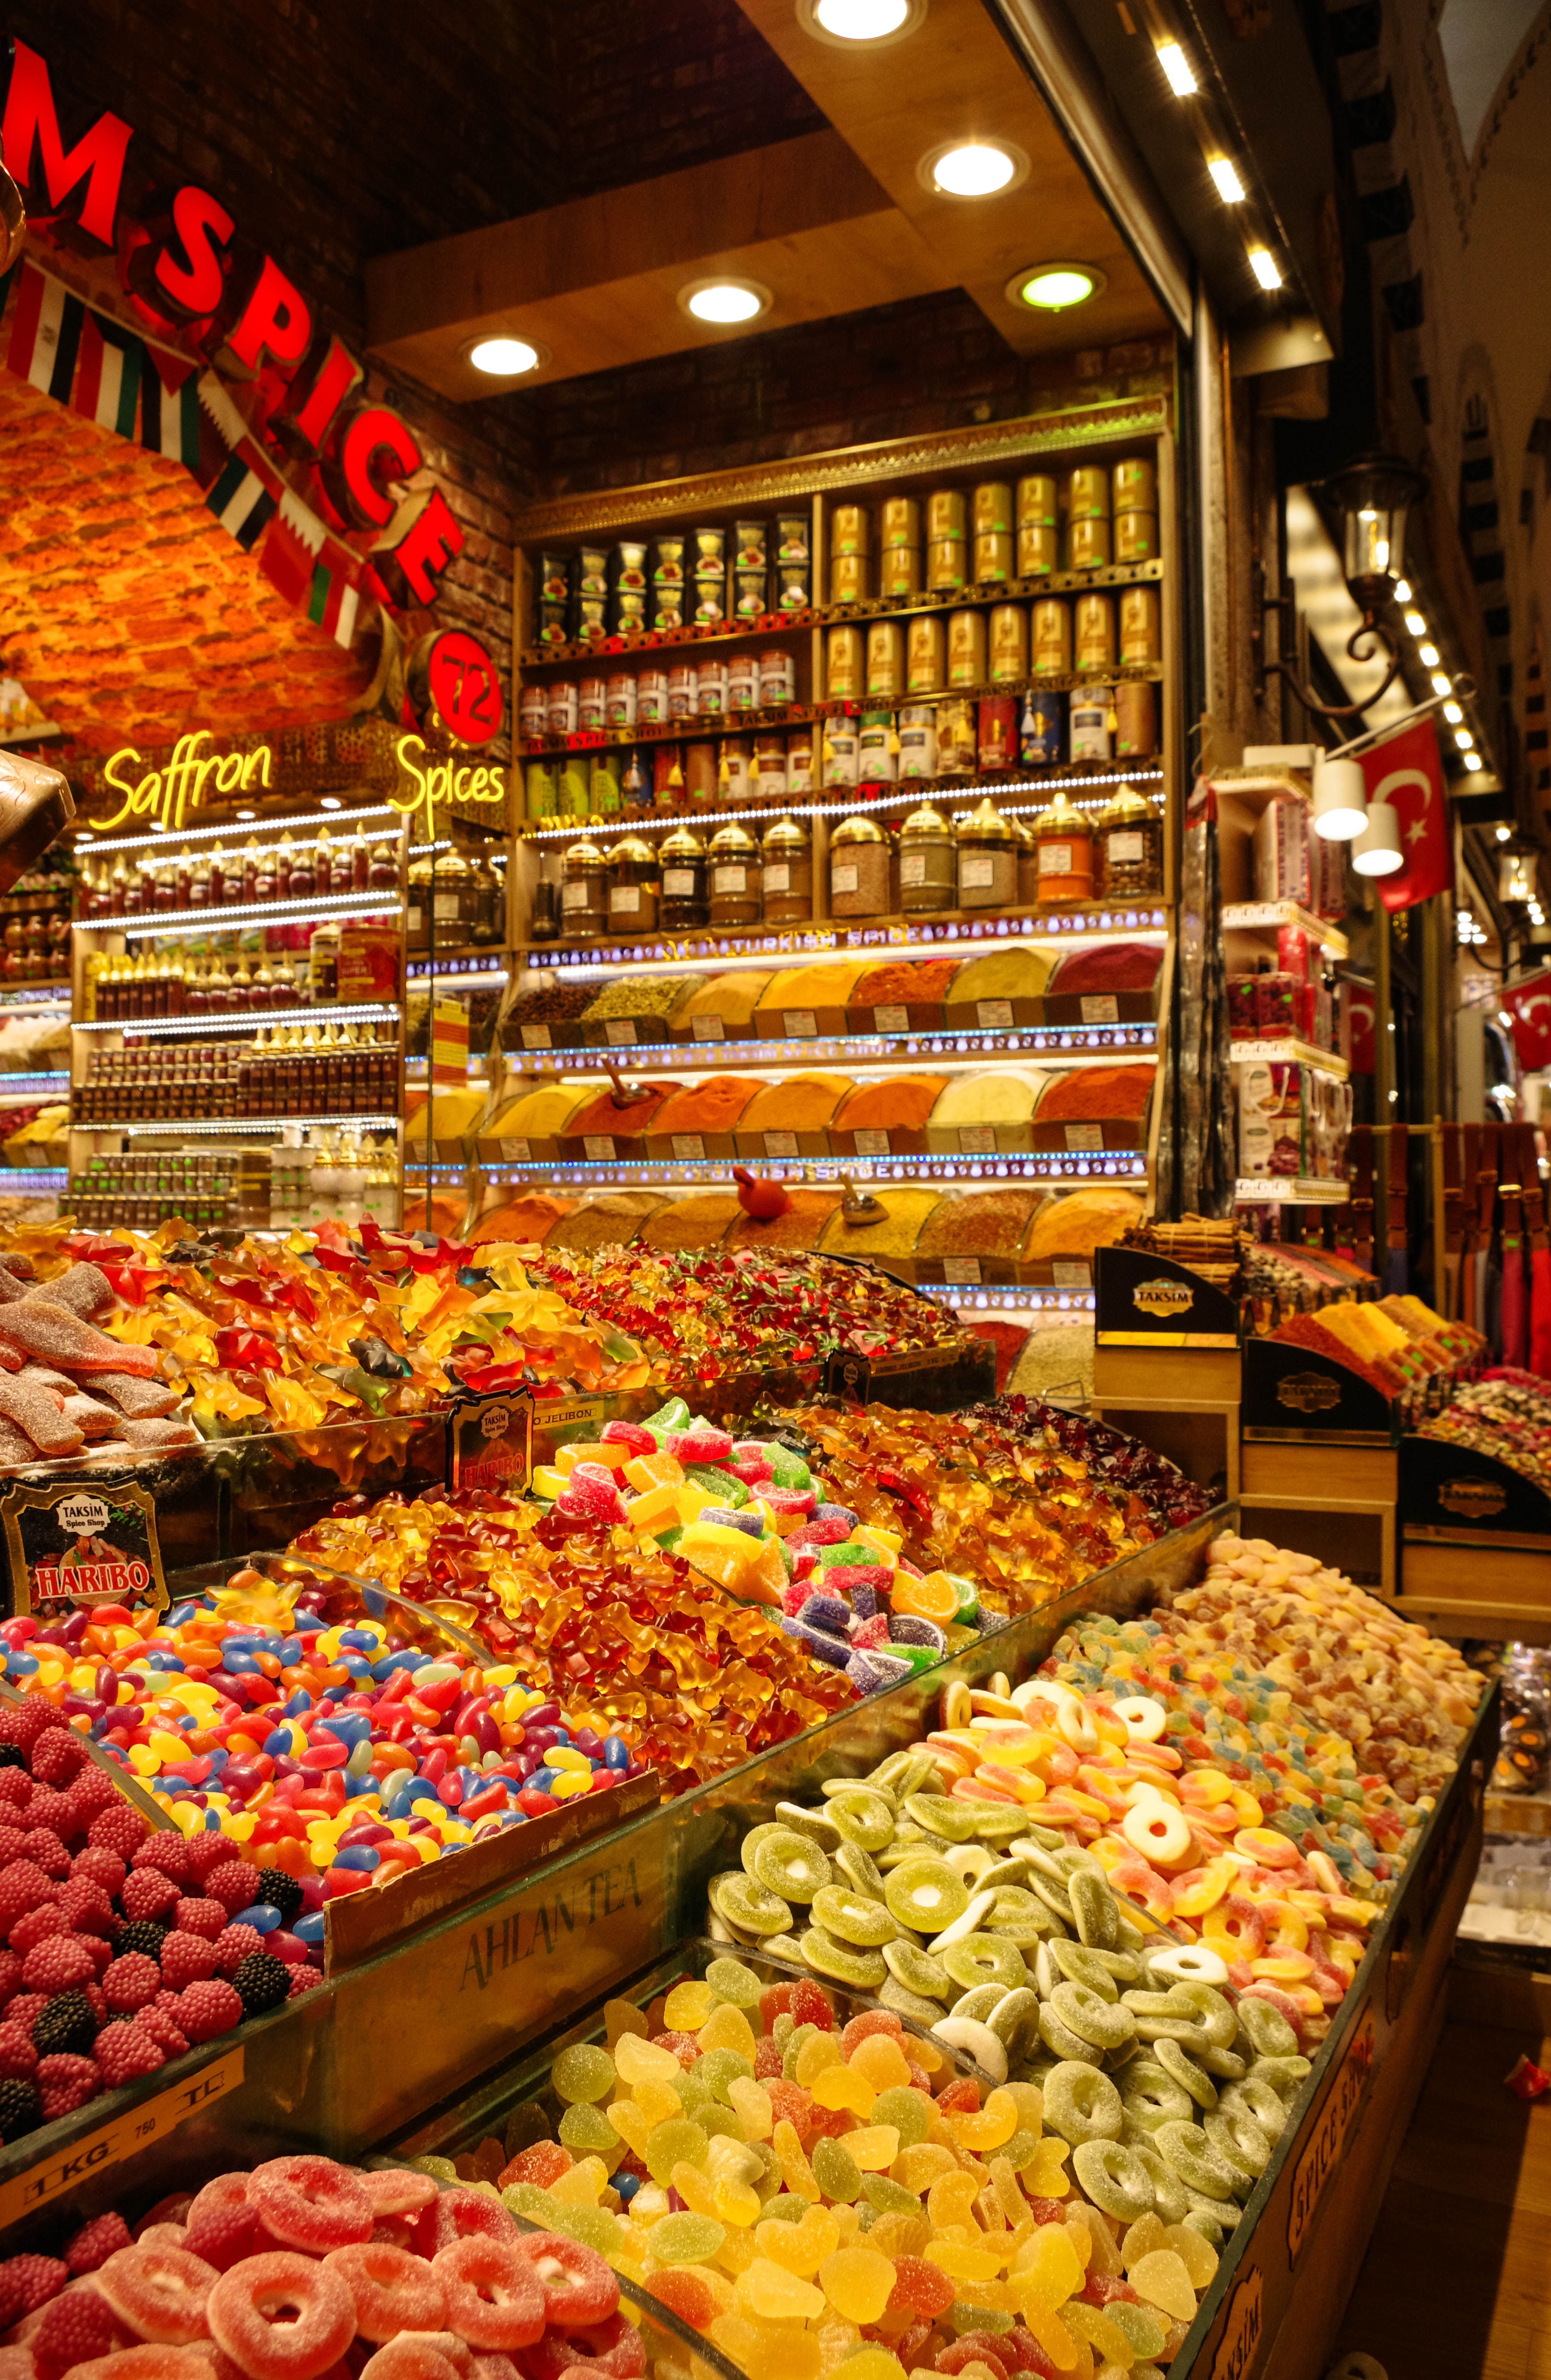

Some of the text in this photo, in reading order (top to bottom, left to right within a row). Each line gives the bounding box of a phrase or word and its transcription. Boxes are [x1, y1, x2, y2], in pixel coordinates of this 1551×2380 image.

[155, 186, 464, 606] SPICE
[443, 654, 493, 725] 72
[89, 730, 271, 831] Saffron
[388, 735, 504, 840] Spices
[545, 1409, 592, 1424] JELIBON
[464, 1453, 523, 1488] HARIBO
[67, 1519, 105, 1527] Spice Shop
[36, 1561, 150, 1599] HARIBO
[459, 1855, 643, 1992] AHLAN TEA
[62, 2142, 109, 2181] KG
[135, 2118, 156, 2139] 750
[183, 2078, 223, 2107] TL
[1295, 2106, 1337, 2239] SPICE
[1226, 2293, 1260, 2380] KSİM
